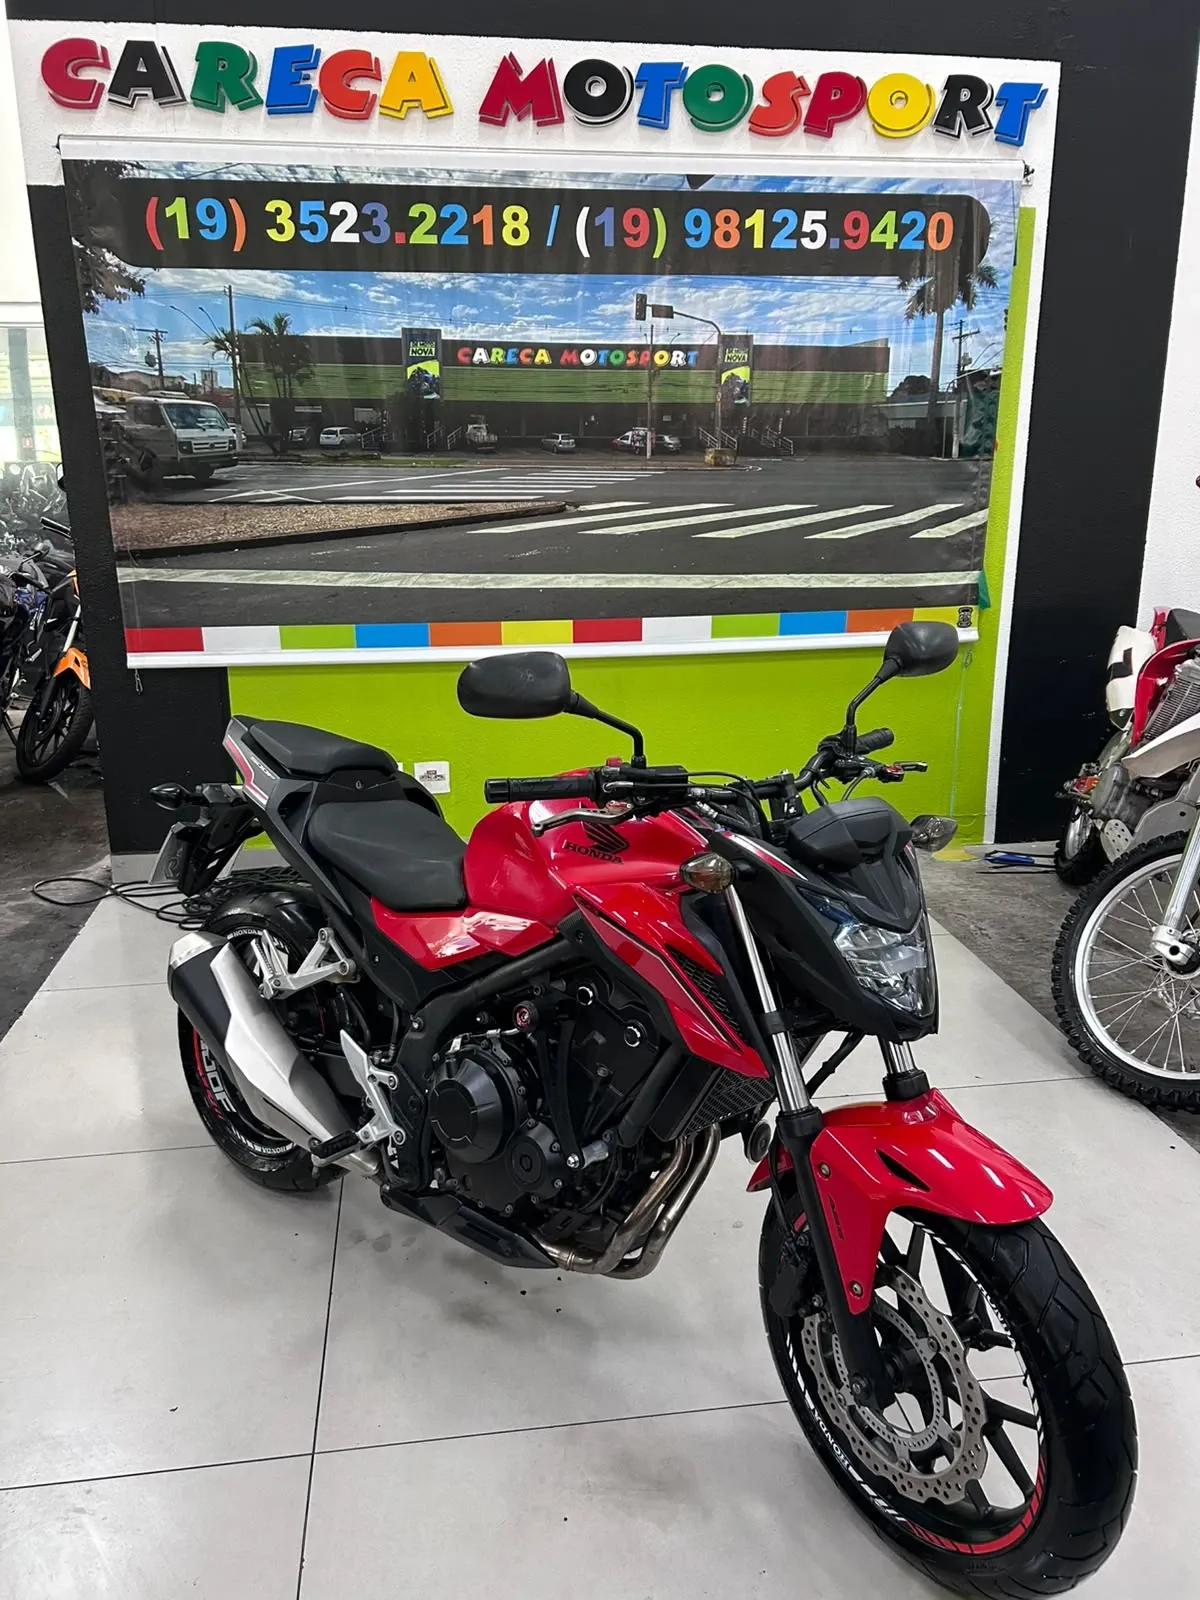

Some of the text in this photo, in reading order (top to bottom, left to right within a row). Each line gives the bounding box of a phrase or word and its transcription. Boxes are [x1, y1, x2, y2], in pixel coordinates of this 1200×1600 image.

[41, 37, 1047, 146] CARECA MOTOSPORT
[146, 196, 954, 258] (19) 3523.2218 / (19) 98125.9420
[411, 348, 433, 356] NOVA
[457, 347, 698, 367] CARECA MOTOSPORT
[563, 841, 622, 864] HONDA
[233, 929, 258, 937] HONDA
[813, 1409, 849, 1468] HONDA
